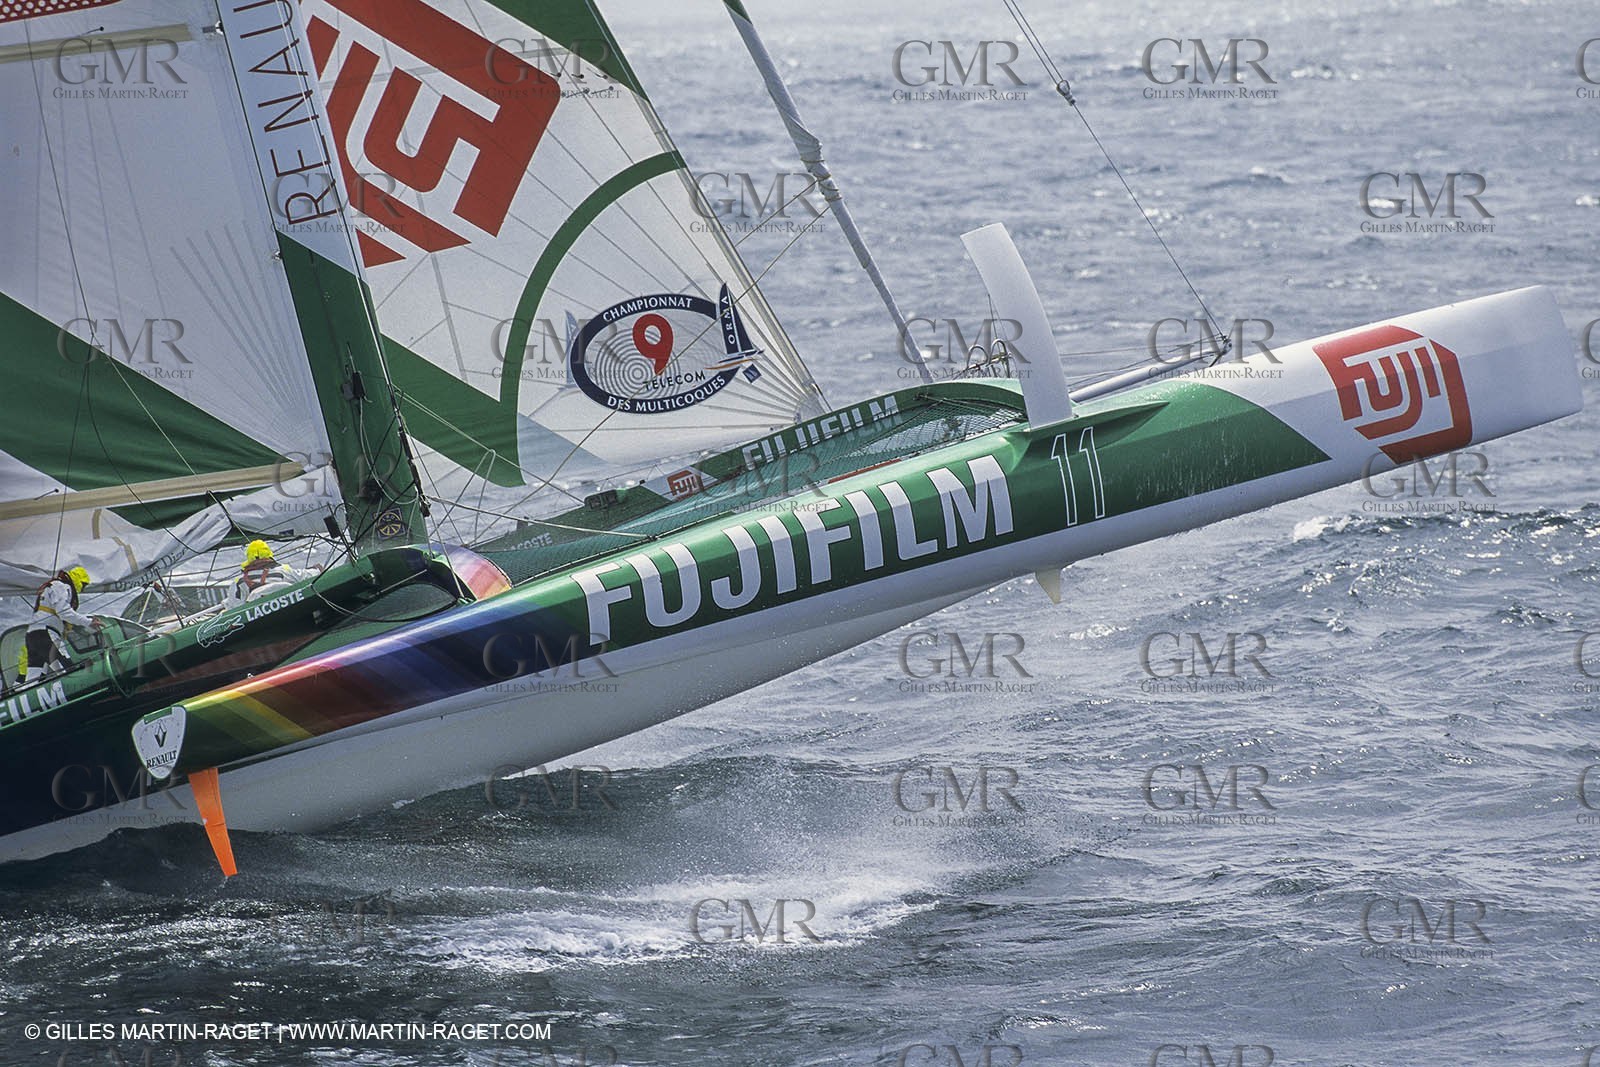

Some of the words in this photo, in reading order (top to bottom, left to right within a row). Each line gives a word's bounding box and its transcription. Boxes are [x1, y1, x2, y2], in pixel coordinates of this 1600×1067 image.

[602, 297, 692, 322] CHAMPIONNAT
[632, 313, 674, 377] 9
[607, 395, 632, 411] DES
[635, 375, 726, 412] MULTICOQUES
[1050, 426, 1105, 526] 11
[570, 454, 1015, 646] FUJIFILM
[246, 588, 305, 621] LACOSTE
[146, 749, 178, 769] RENAULT
